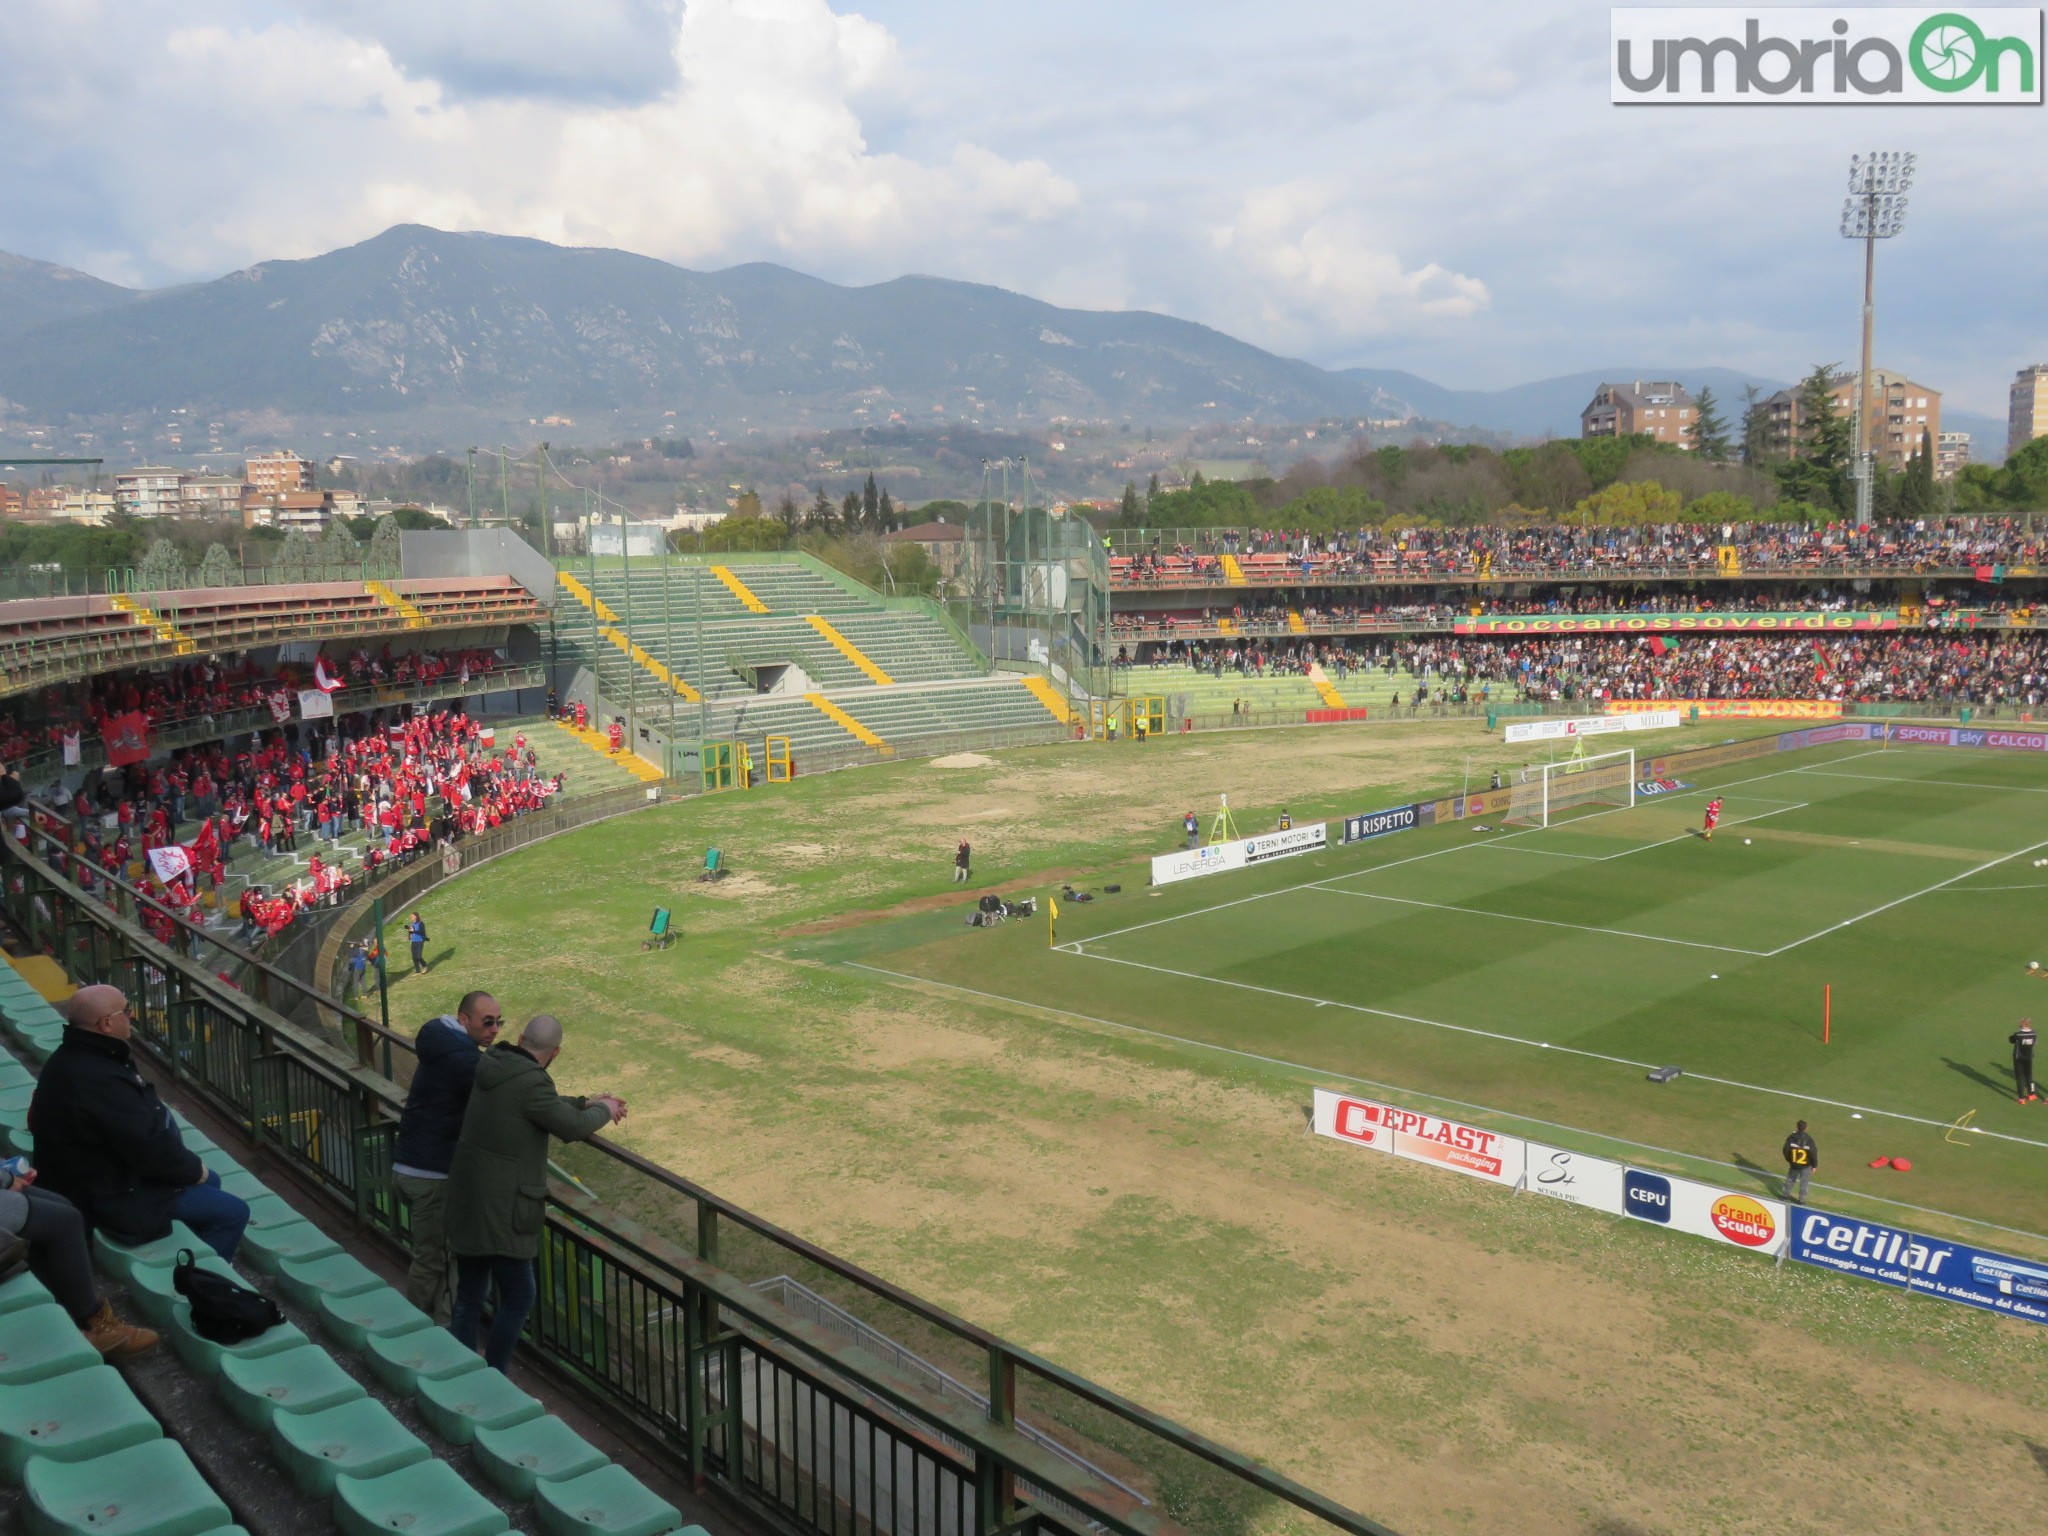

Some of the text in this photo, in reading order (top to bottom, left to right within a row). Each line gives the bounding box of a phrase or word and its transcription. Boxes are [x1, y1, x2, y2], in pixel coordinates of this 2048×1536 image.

[1488, 612, 1854, 631] roccarossoverde
[1748, 701, 1837, 718] NORD
[1872, 726, 1895, 740] sky
[1900, 727, 1948, 742] SPORT
[1960, 731, 2042, 748] sky CALCIO
[1363, 810, 1414, 834] RISPETTO
[1257, 832, 1309, 851] TERNI MOTORI
[1173, 856, 1227, 875] LENERGIA
[1447, 1150, 1498, 1172] packaging
[1792, 1148, 1808, 1165] 12
[1537, 1187, 1564, 1199] SCUOLA
[1629, 1187, 1667, 1207] CEPU
[1718, 1203, 1768, 1226] Grandi
[1717, 1215, 1768, 1239] Scuole
[1801, 1214, 1952, 1275] Cetilar
[1975, 1265, 2015, 1280] Cetilar
[1802, 1248, 2047, 1318] Il massaggio con Cetilar aiuta la riduzione del dolore
[2015, 1283, 2048, 1298] Cetila
